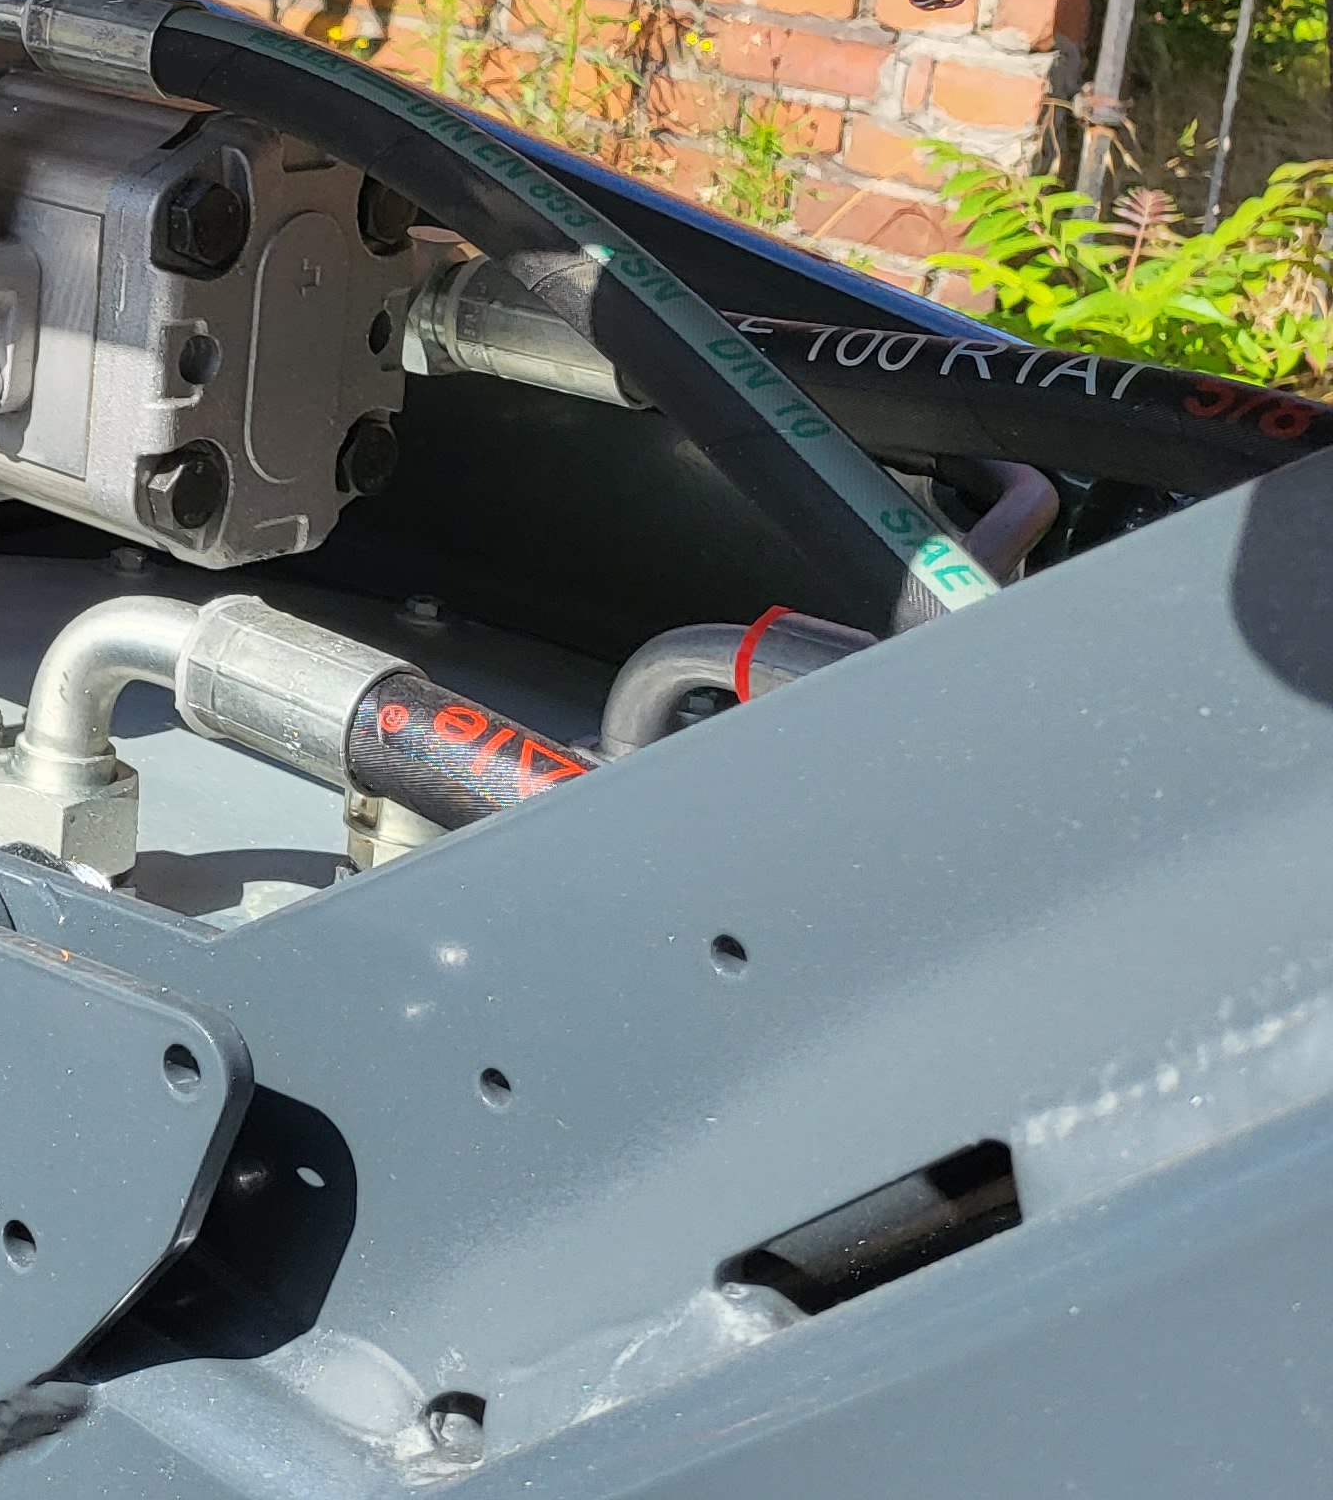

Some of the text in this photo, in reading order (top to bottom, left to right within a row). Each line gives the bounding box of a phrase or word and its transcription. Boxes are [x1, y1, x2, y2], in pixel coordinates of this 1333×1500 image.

[406, 101, 485, 142] DIN
[471, 143, 533, 180] EN
[529, 183, 600, 228] 853
[705, 337, 783, 390] DN
[774, 399, 832, 439] 10
[879, 507, 987, 592] SAE
[805, 327, 931, 372] 100
